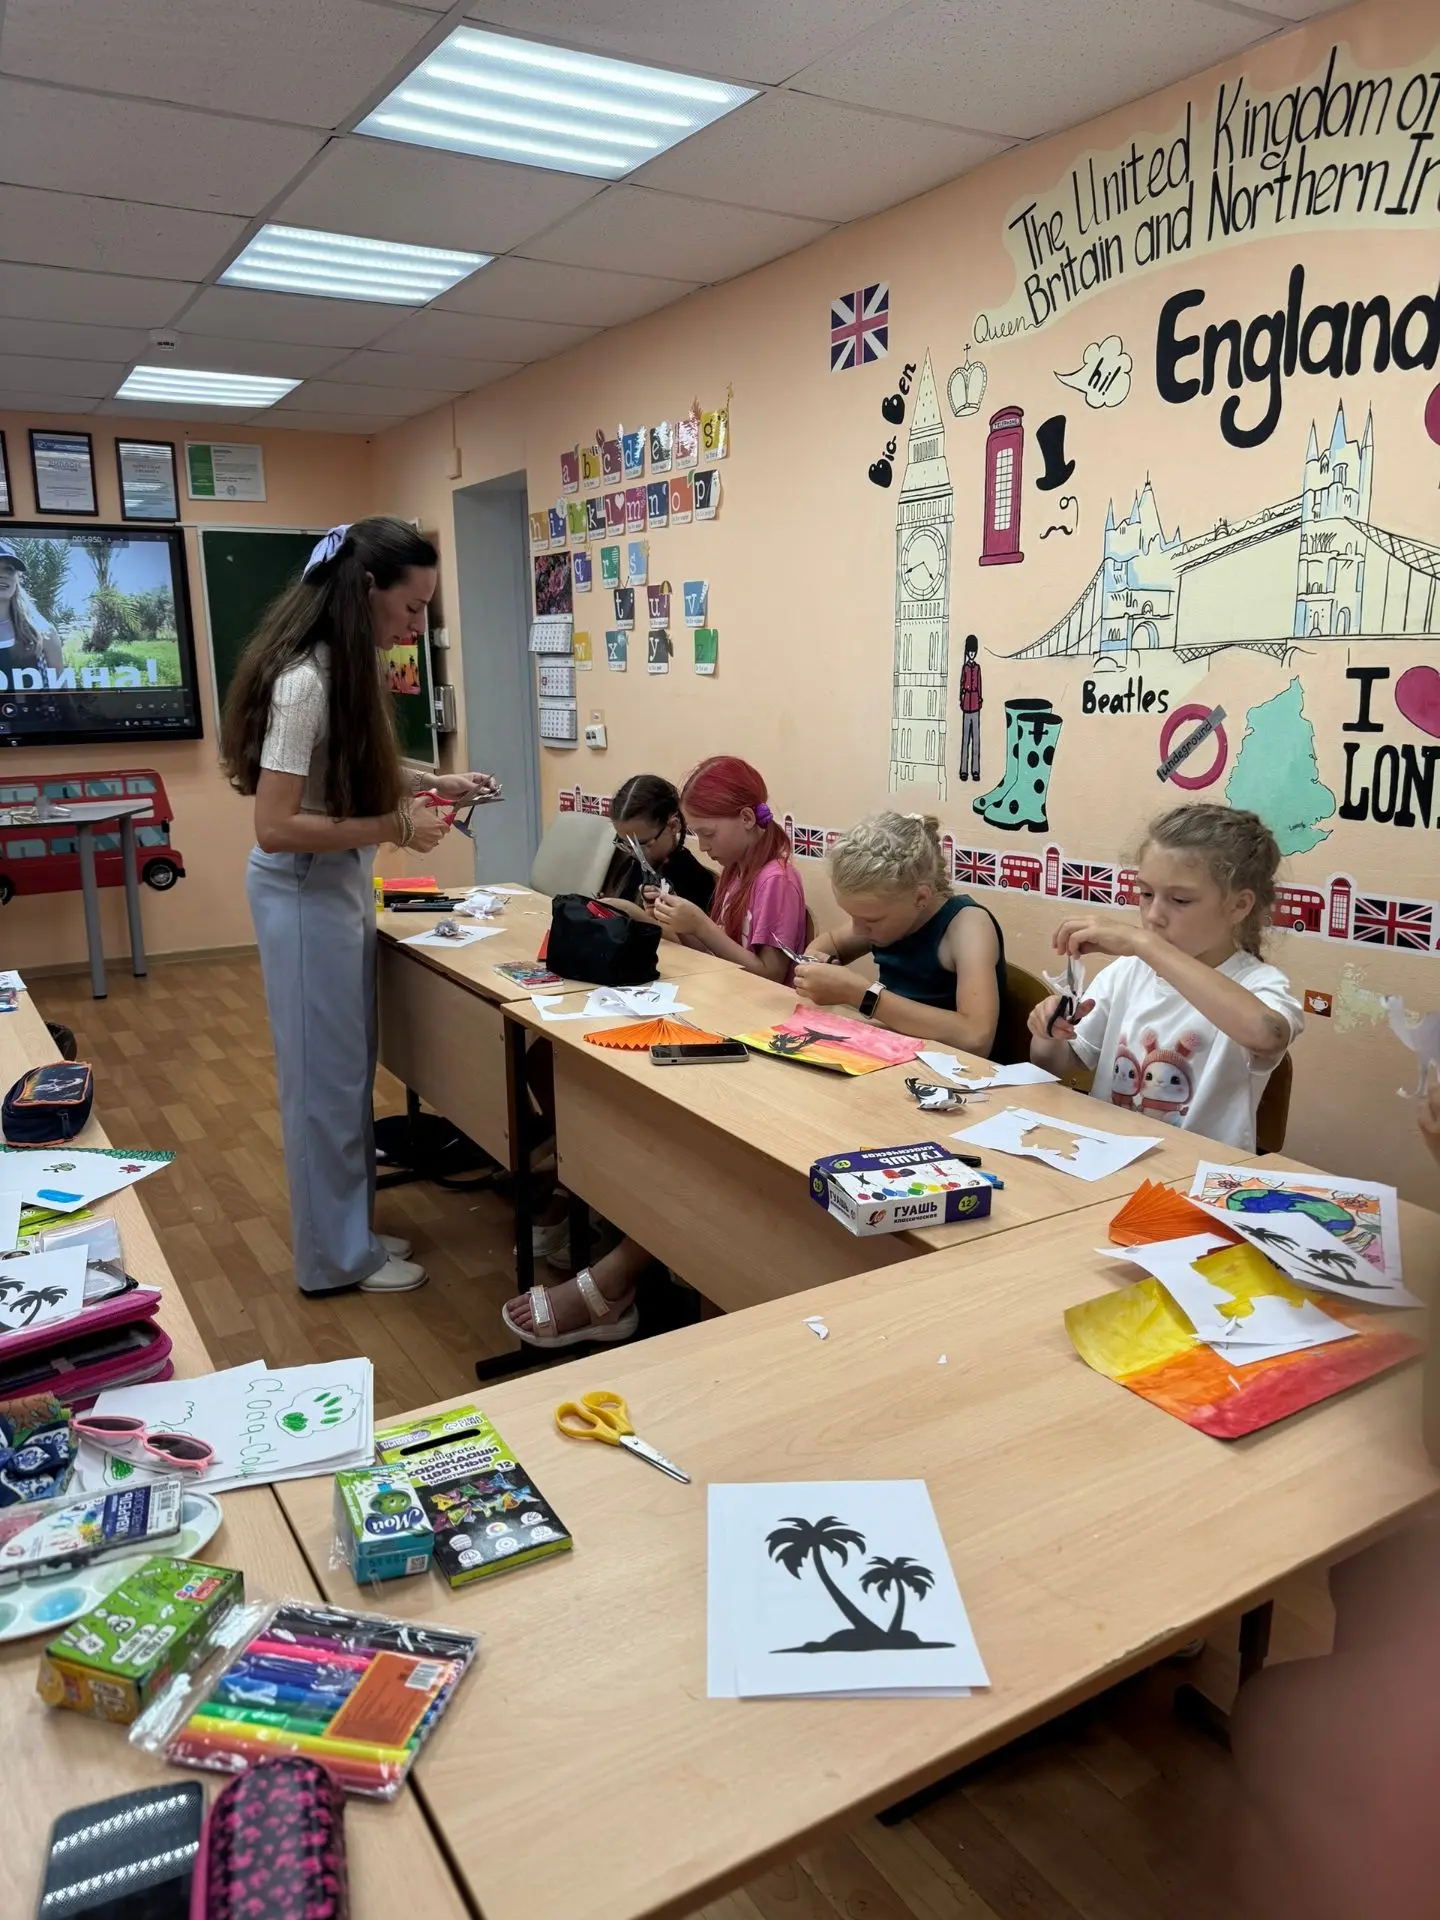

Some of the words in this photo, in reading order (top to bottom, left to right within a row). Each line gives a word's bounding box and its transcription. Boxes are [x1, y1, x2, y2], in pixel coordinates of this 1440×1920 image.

[1008, 202, 1066, 270] The
[1072, 101, 1194, 236] United
[1212, 46, 1392, 171] Kingdom
[1024, 235, 1125, 326] Britain
[1135, 180, 1194, 266] and
[1207, 144, 1390, 241] Northern
[1384, 133, 1440, 216] Ir
[973, 313, 1048, 344] Queen
[1156, 264, 1440, 448] England
[882, 363, 917, 425] Ben
[1087, 358, 1121, 396] hi!
[562, 463, 570, 484] a
[583, 454, 591, 479] b
[604, 453, 612, 473] c
[626, 499, 642, 521] m
[649, 493, 660, 516] n
[695, 479, 706, 507] p
[1082, 676, 1170, 715] Beatles
[1342, 667, 1391, 732] I
[1339, 742, 1440, 829] LON
[861, 1145, 935, 1159] классическая
[879, 1150, 944, 1166] ГУАШЬ
[894, 1201, 938, 1218] ГУАШЬ
[407, 1447, 500, 1478] карандаши
[419, 1445, 477, 1466] Calligrata
[420, 1456, 493, 1482] цветные
[499, 1461, 513, 1469] 12
